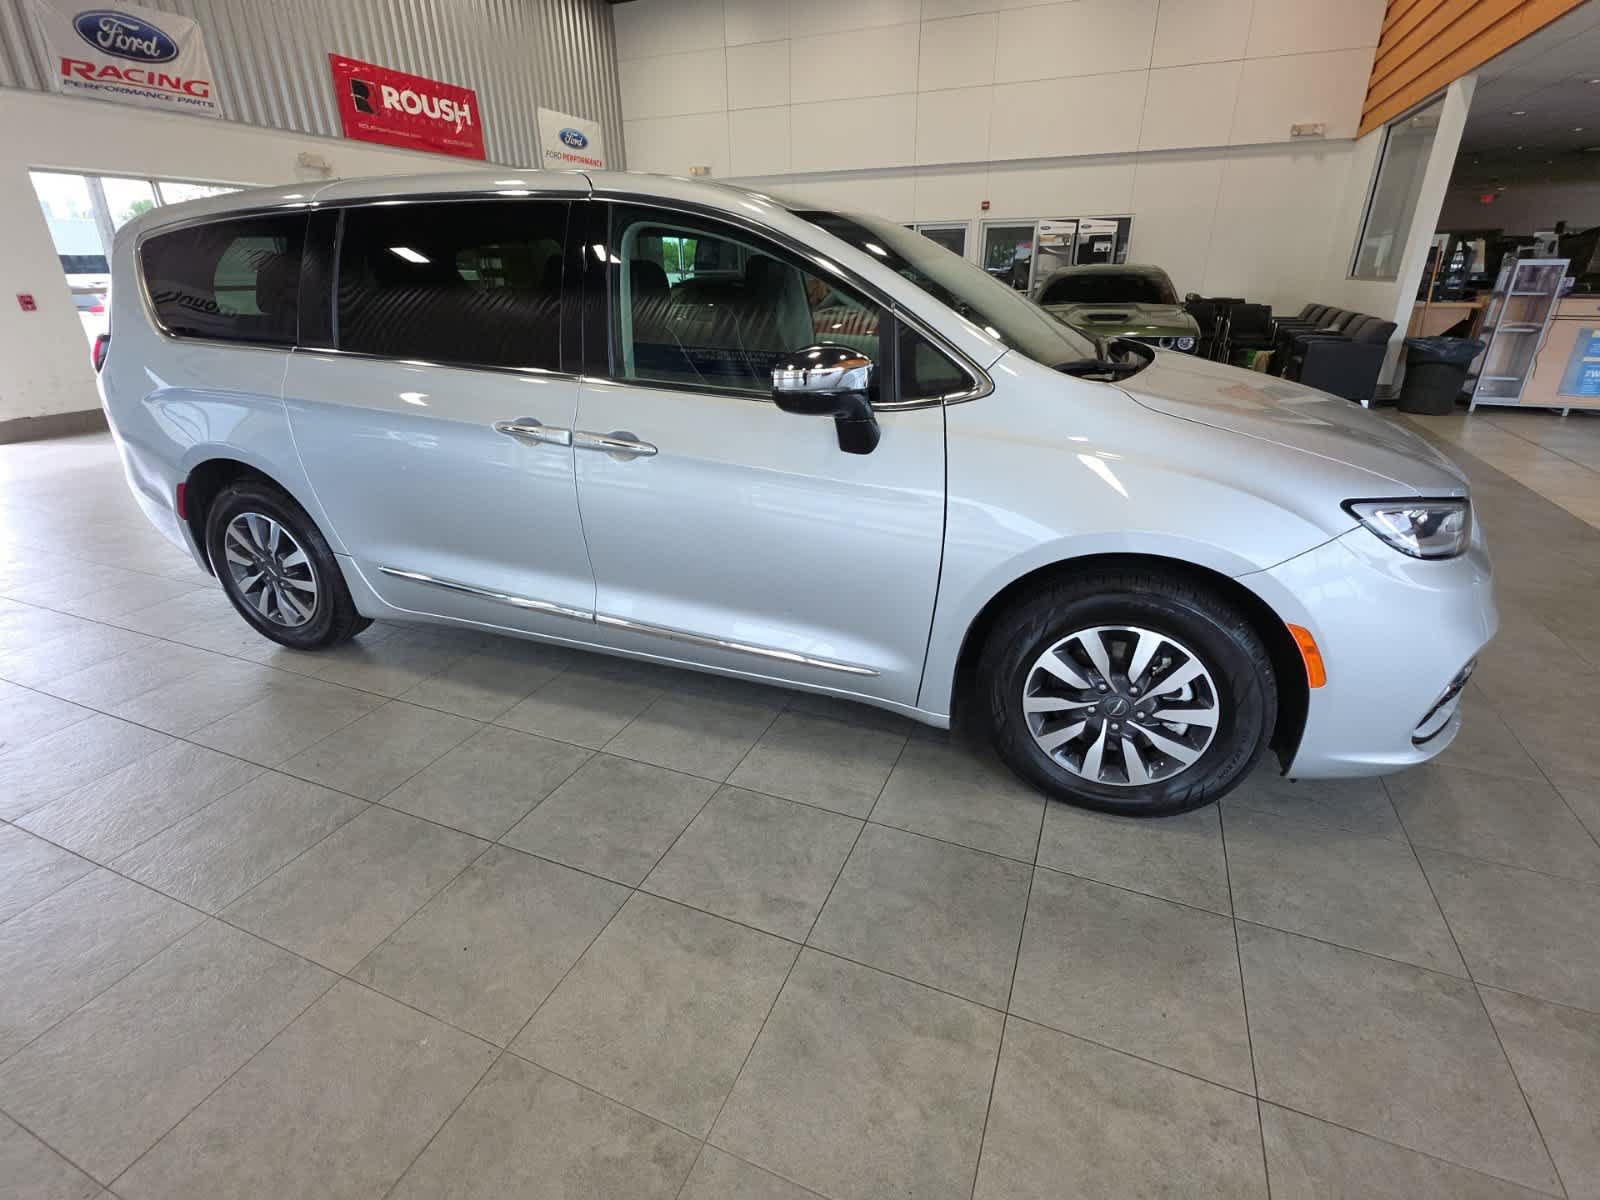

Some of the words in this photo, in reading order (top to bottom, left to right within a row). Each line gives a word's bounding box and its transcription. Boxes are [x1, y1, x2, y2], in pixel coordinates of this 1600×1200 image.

[97, 17, 161, 57] Ford
[61, 57, 209, 98] RACING
[63, 79, 173, 101] PERFORMANCE
[177, 95, 215, 108] PARTS
[381, 85, 472, 126] ROUSH
[545, 150, 562, 160] FORD
